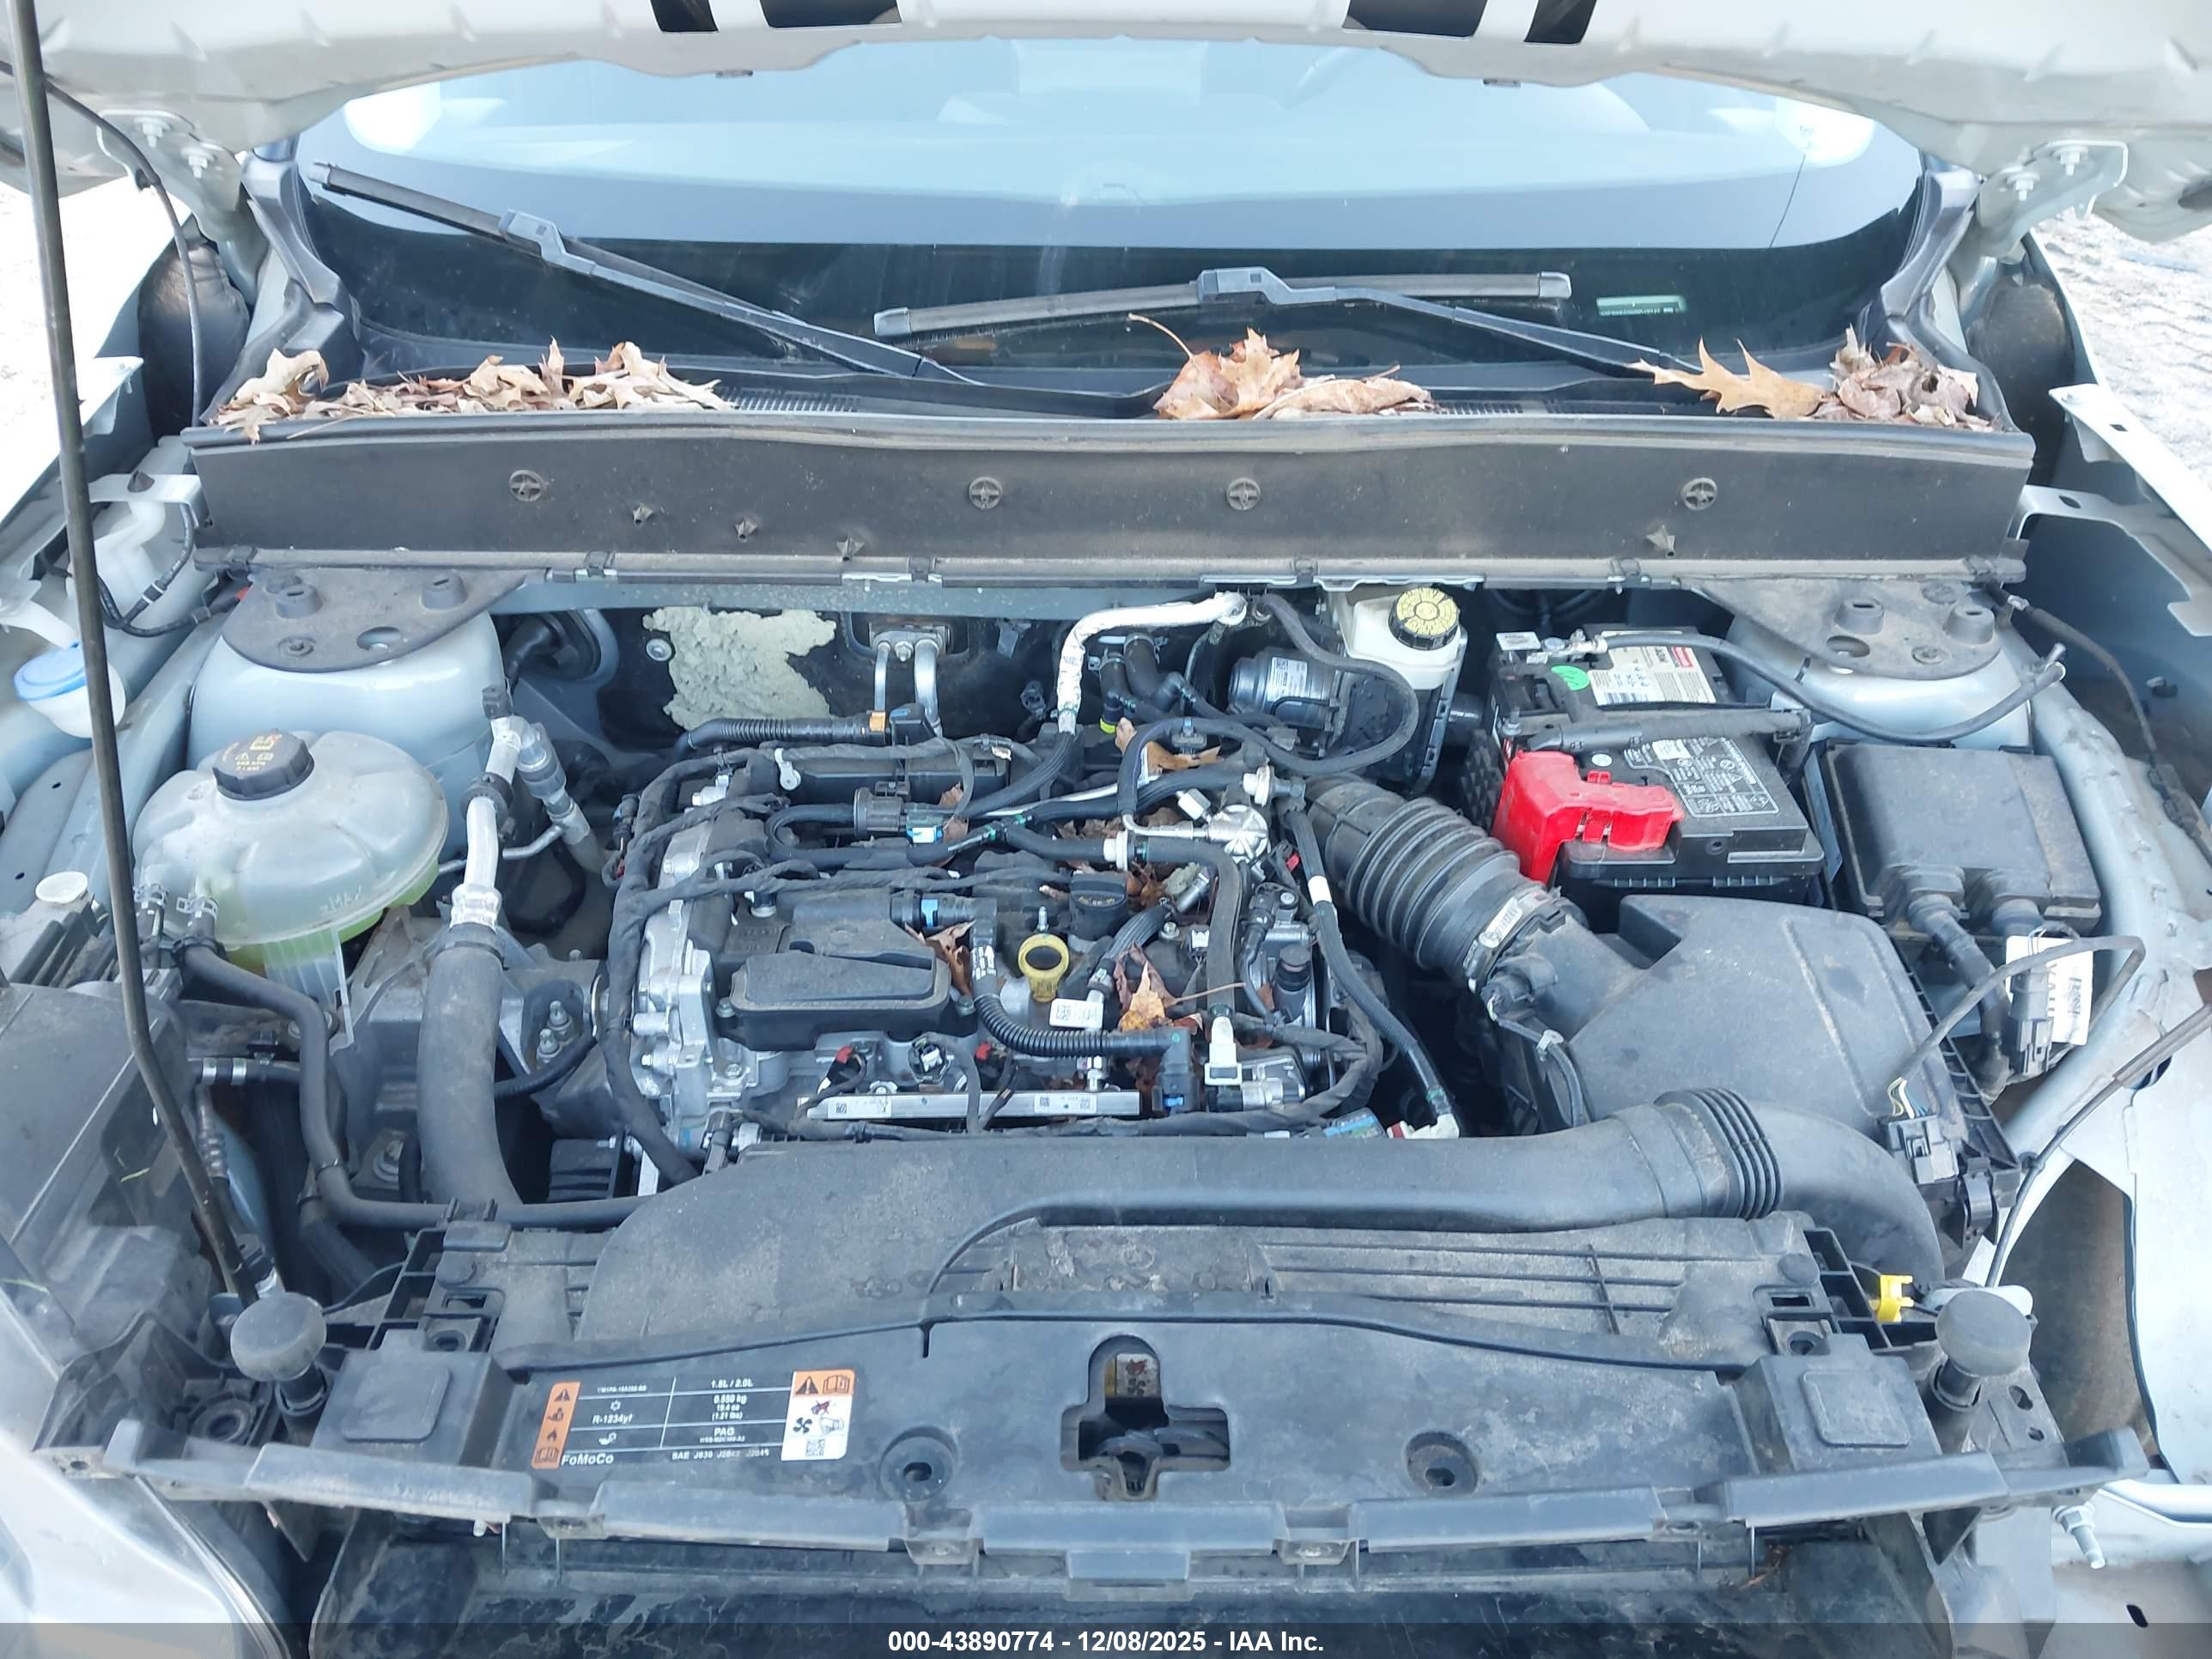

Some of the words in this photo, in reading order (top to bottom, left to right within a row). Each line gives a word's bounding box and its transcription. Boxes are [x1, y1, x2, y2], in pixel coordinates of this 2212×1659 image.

[734, 1377, 754, 1388] 2.0L
[736, 1393, 748, 1405] kg
[592, 1413, 634, 1425] R-1234yf
[714, 1426, 735, 1437] PAG
[561, 1452, 615, 1467] FoMoCo
